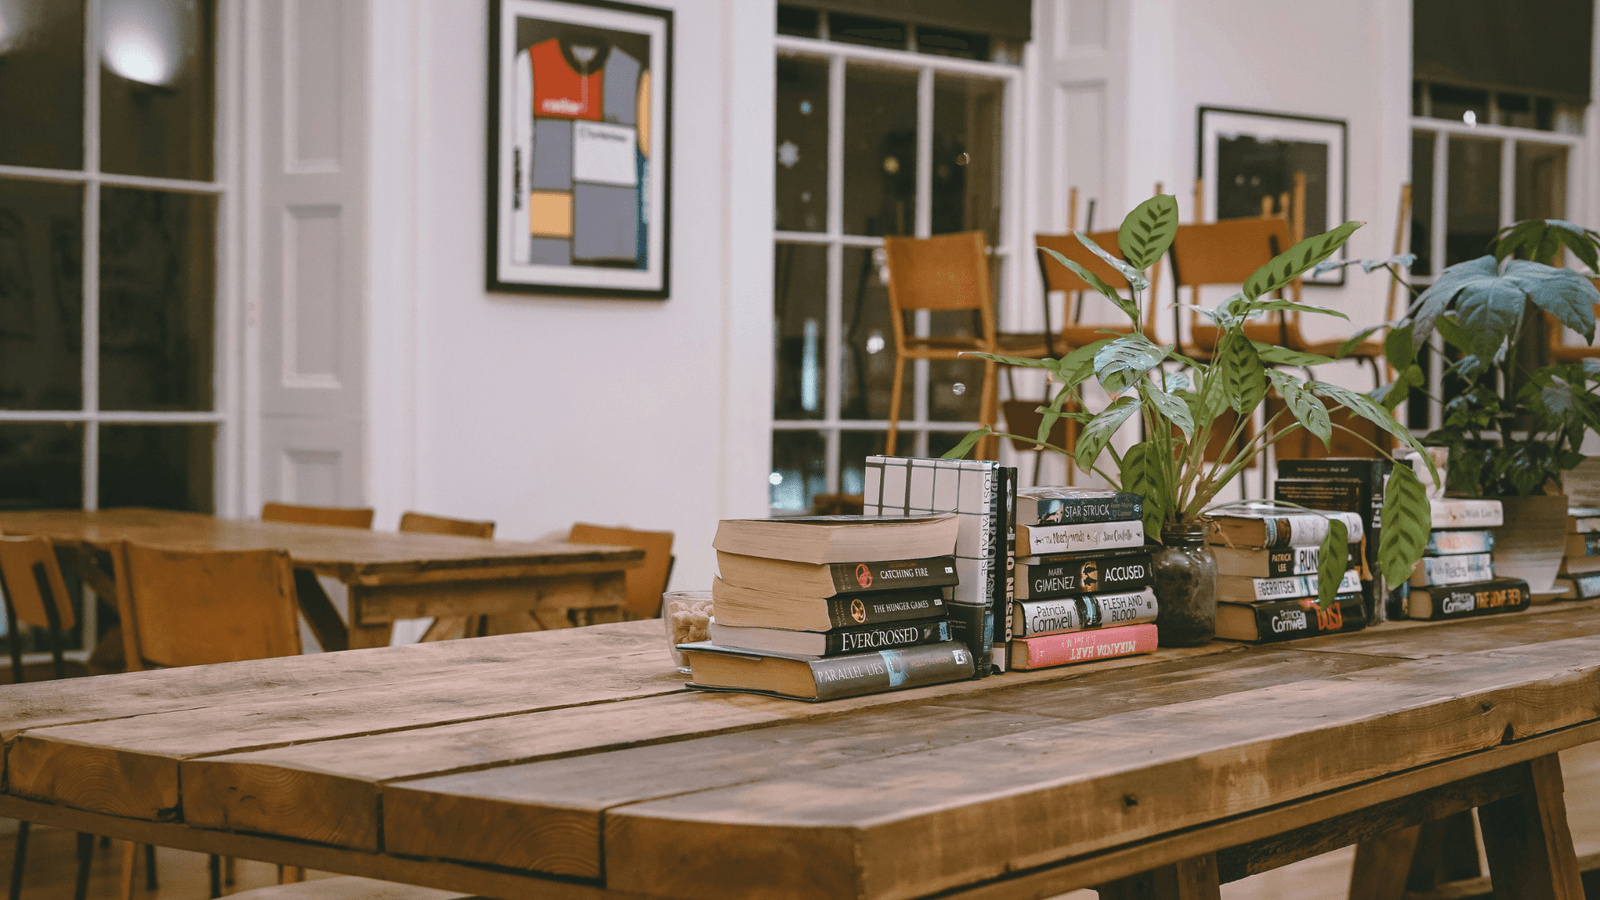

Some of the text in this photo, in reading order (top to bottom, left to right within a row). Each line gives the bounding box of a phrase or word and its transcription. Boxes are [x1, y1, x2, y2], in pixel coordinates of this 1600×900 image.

[983, 472, 991, 505] LOST
[1064, 504, 1110, 518] STAR STRUCK
[1006, 545, 1015, 571] JO
[1272, 553, 1292, 562] PATRICK
[880, 567, 929, 580] CATCHING FIRE
[1048, 567, 1064, 577] MARK
[1104, 565, 1145, 583] ACCUSED
[1277, 563, 1287, 572] LEE
[1035, 576, 1075, 593] GIMENEZ
[1261, 580, 1296, 596] GERRITSEN
[873, 604, 886, 614] THE
[886, 602, 911, 612] HUNGER
[910, 600, 930, 610] GAMES
[1103, 595, 1143, 611] FLESH AND
[1036, 605, 1066, 618] Patricia
[1111, 608, 1137, 622] BLOOD
[1032, 614, 1073, 633] Cornwell
[1272, 612, 1307, 633] Cornwell
[841, 626, 919, 651] EVERCROSSED
[1069, 645, 1094, 660] HART
[1096, 640, 1136, 656] MIRANDA
[817, 662, 884, 683] PARALLEL LIES
